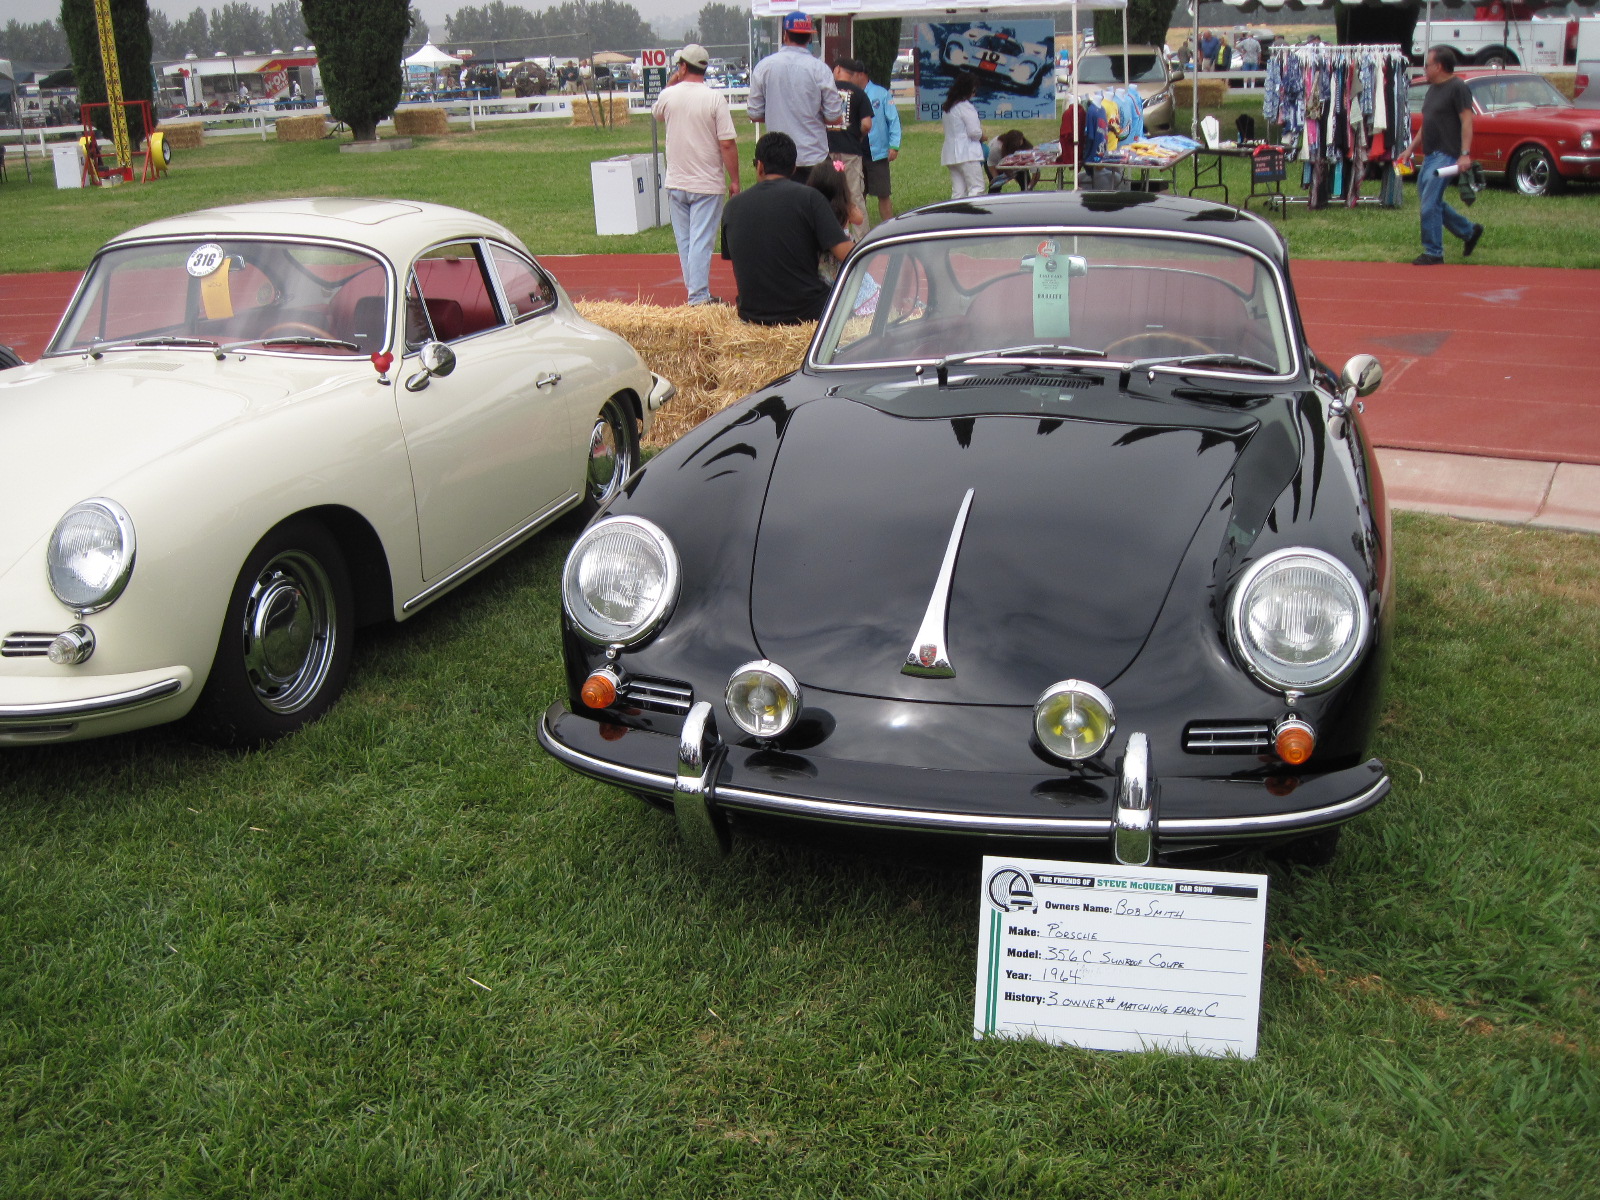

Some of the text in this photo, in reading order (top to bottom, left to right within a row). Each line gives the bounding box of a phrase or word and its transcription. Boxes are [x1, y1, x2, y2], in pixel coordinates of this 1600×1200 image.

[642, 50, 666, 66] NO
[981, 51, 1000, 63] 10
[193, 253, 217, 267] 316
[1053, 877, 1081, 885] FRIENDS
[1097, 879, 1128, 888] STEVE
[1130, 881, 1173, 891] McQUEEN
[1045, 900, 1080, 911] Owners
[1083, 903, 1112, 913] Name:
[1008, 925, 1040, 937] Make:
[1007, 947, 1041, 959] Model:
[1006, 967, 1081, 984] Year: 1964
[1004, 991, 1045, 1005] History:
[1047, 990, 1058, 1006] 3
